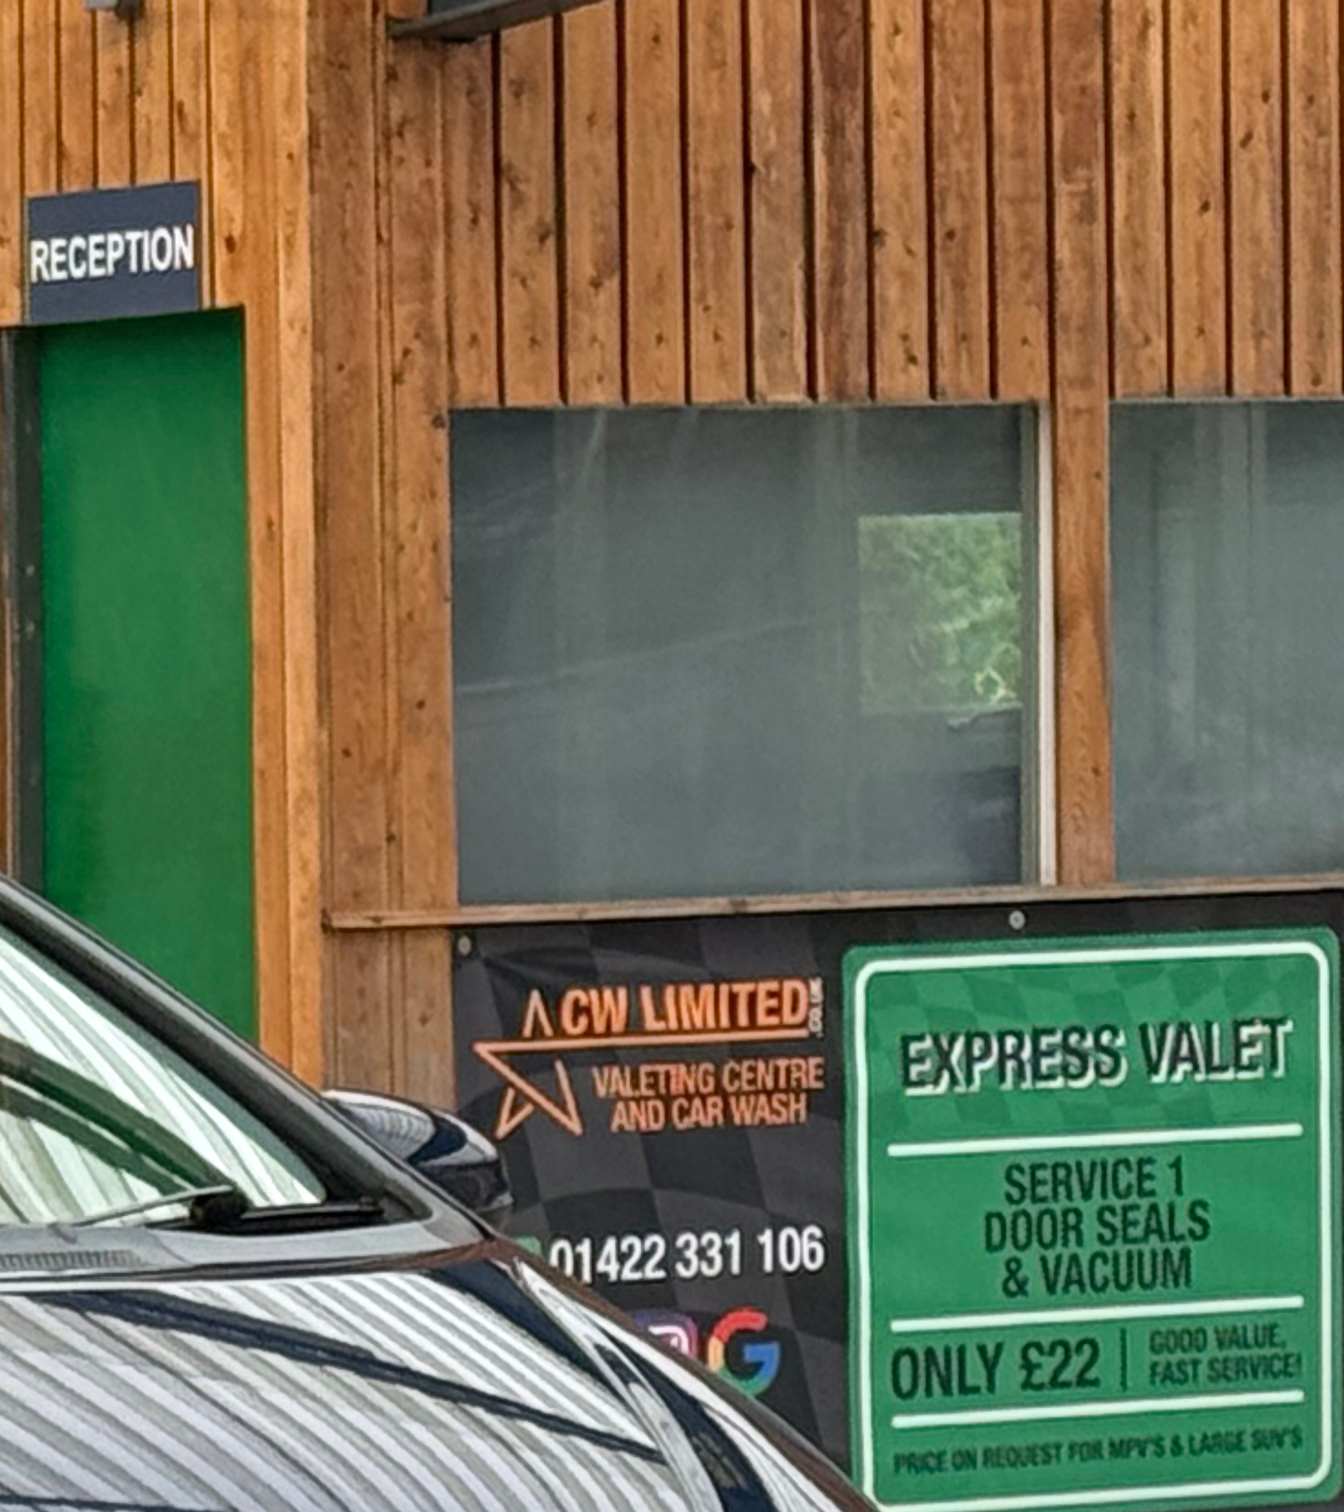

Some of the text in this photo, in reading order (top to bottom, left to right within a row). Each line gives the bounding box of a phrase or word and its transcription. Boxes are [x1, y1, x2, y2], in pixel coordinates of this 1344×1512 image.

[30, 223, 194, 283] RECEPTION
[640, 979, 809, 1031] LIMITED
[592, 1057, 825, 1098] VALETING CENTRE
[900, 1016, 1292, 1096] EXPRESS VALET
[611, 1093, 807, 1133] AND CAR WASH
[1004, 1155, 1184, 1205] SERVICE 1
[985, 1201, 1211, 1254] DOOR SEALS
[549, 1224, 824, 1284] 01422 331 106
[1002, 1247, 1192, 1297] & VACUUM
[1149, 1327, 1207, 1355] GOOD
[891, 1337, 1101, 1400] ONLY £22
[1149, 1358, 1201, 1386] FAST
[894, 1449, 947, 1475] PRICE
[951, 1449, 978, 1470] ON
[982, 1441, 1063, 1469] REQUEST
[1067, 1438, 1103, 1461] FOR
[1170, 1434, 1184, 1457] &
[1188, 1430, 1246, 1456] LARGE
